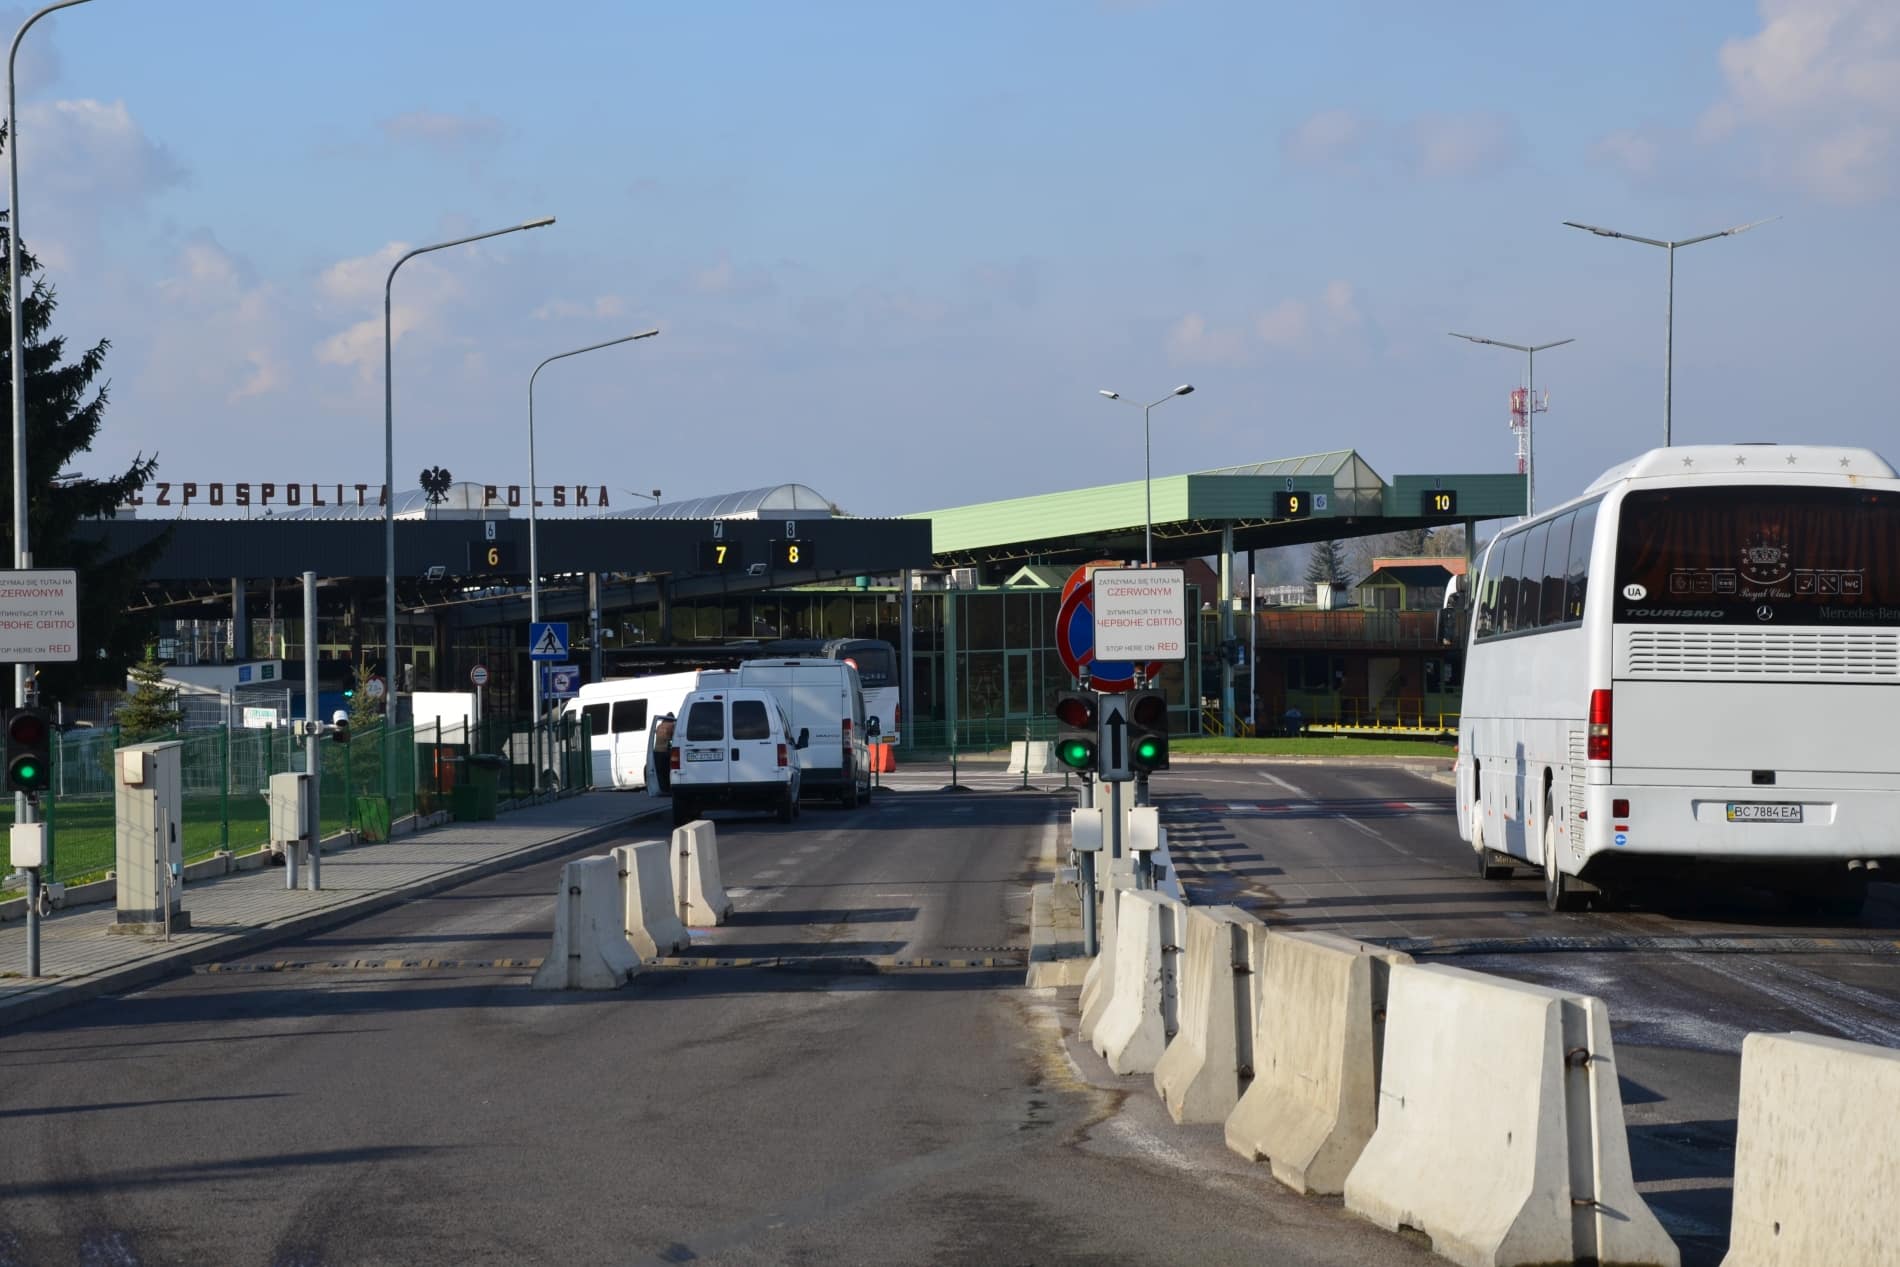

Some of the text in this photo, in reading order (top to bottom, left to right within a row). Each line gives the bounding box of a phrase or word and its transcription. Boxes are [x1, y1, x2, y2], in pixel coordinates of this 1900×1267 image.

[484, 485, 609, 507] POLSKA
[1290, 496, 1299, 513] 9
[1434, 495, 1450, 510] 10
[487, 525, 494, 537] 6
[715, 523, 721, 537] 7
[788, 522, 793, 536] 8
[488, 548, 498, 565] 6
[716, 546, 727, 564] 7
[788, 546, 799, 563] 8
[0, 588, 64, 598] ZERWONYM
[1107, 587, 1172, 597] CZERWONYM
[1627, 588, 1642, 597] UA
[1625, 608, 1725, 618] TOURISMO
[36, 620, 75, 629] СВІТЛО
[1097, 618, 1182, 628] ЧЕРВОНЕ СВІТЛО
[48, 644, 71, 653] RED
[1157, 642, 1179, 651] RED
[1735, 806, 1751, 817] BC
[1753, 806, 1779, 817] 7884
